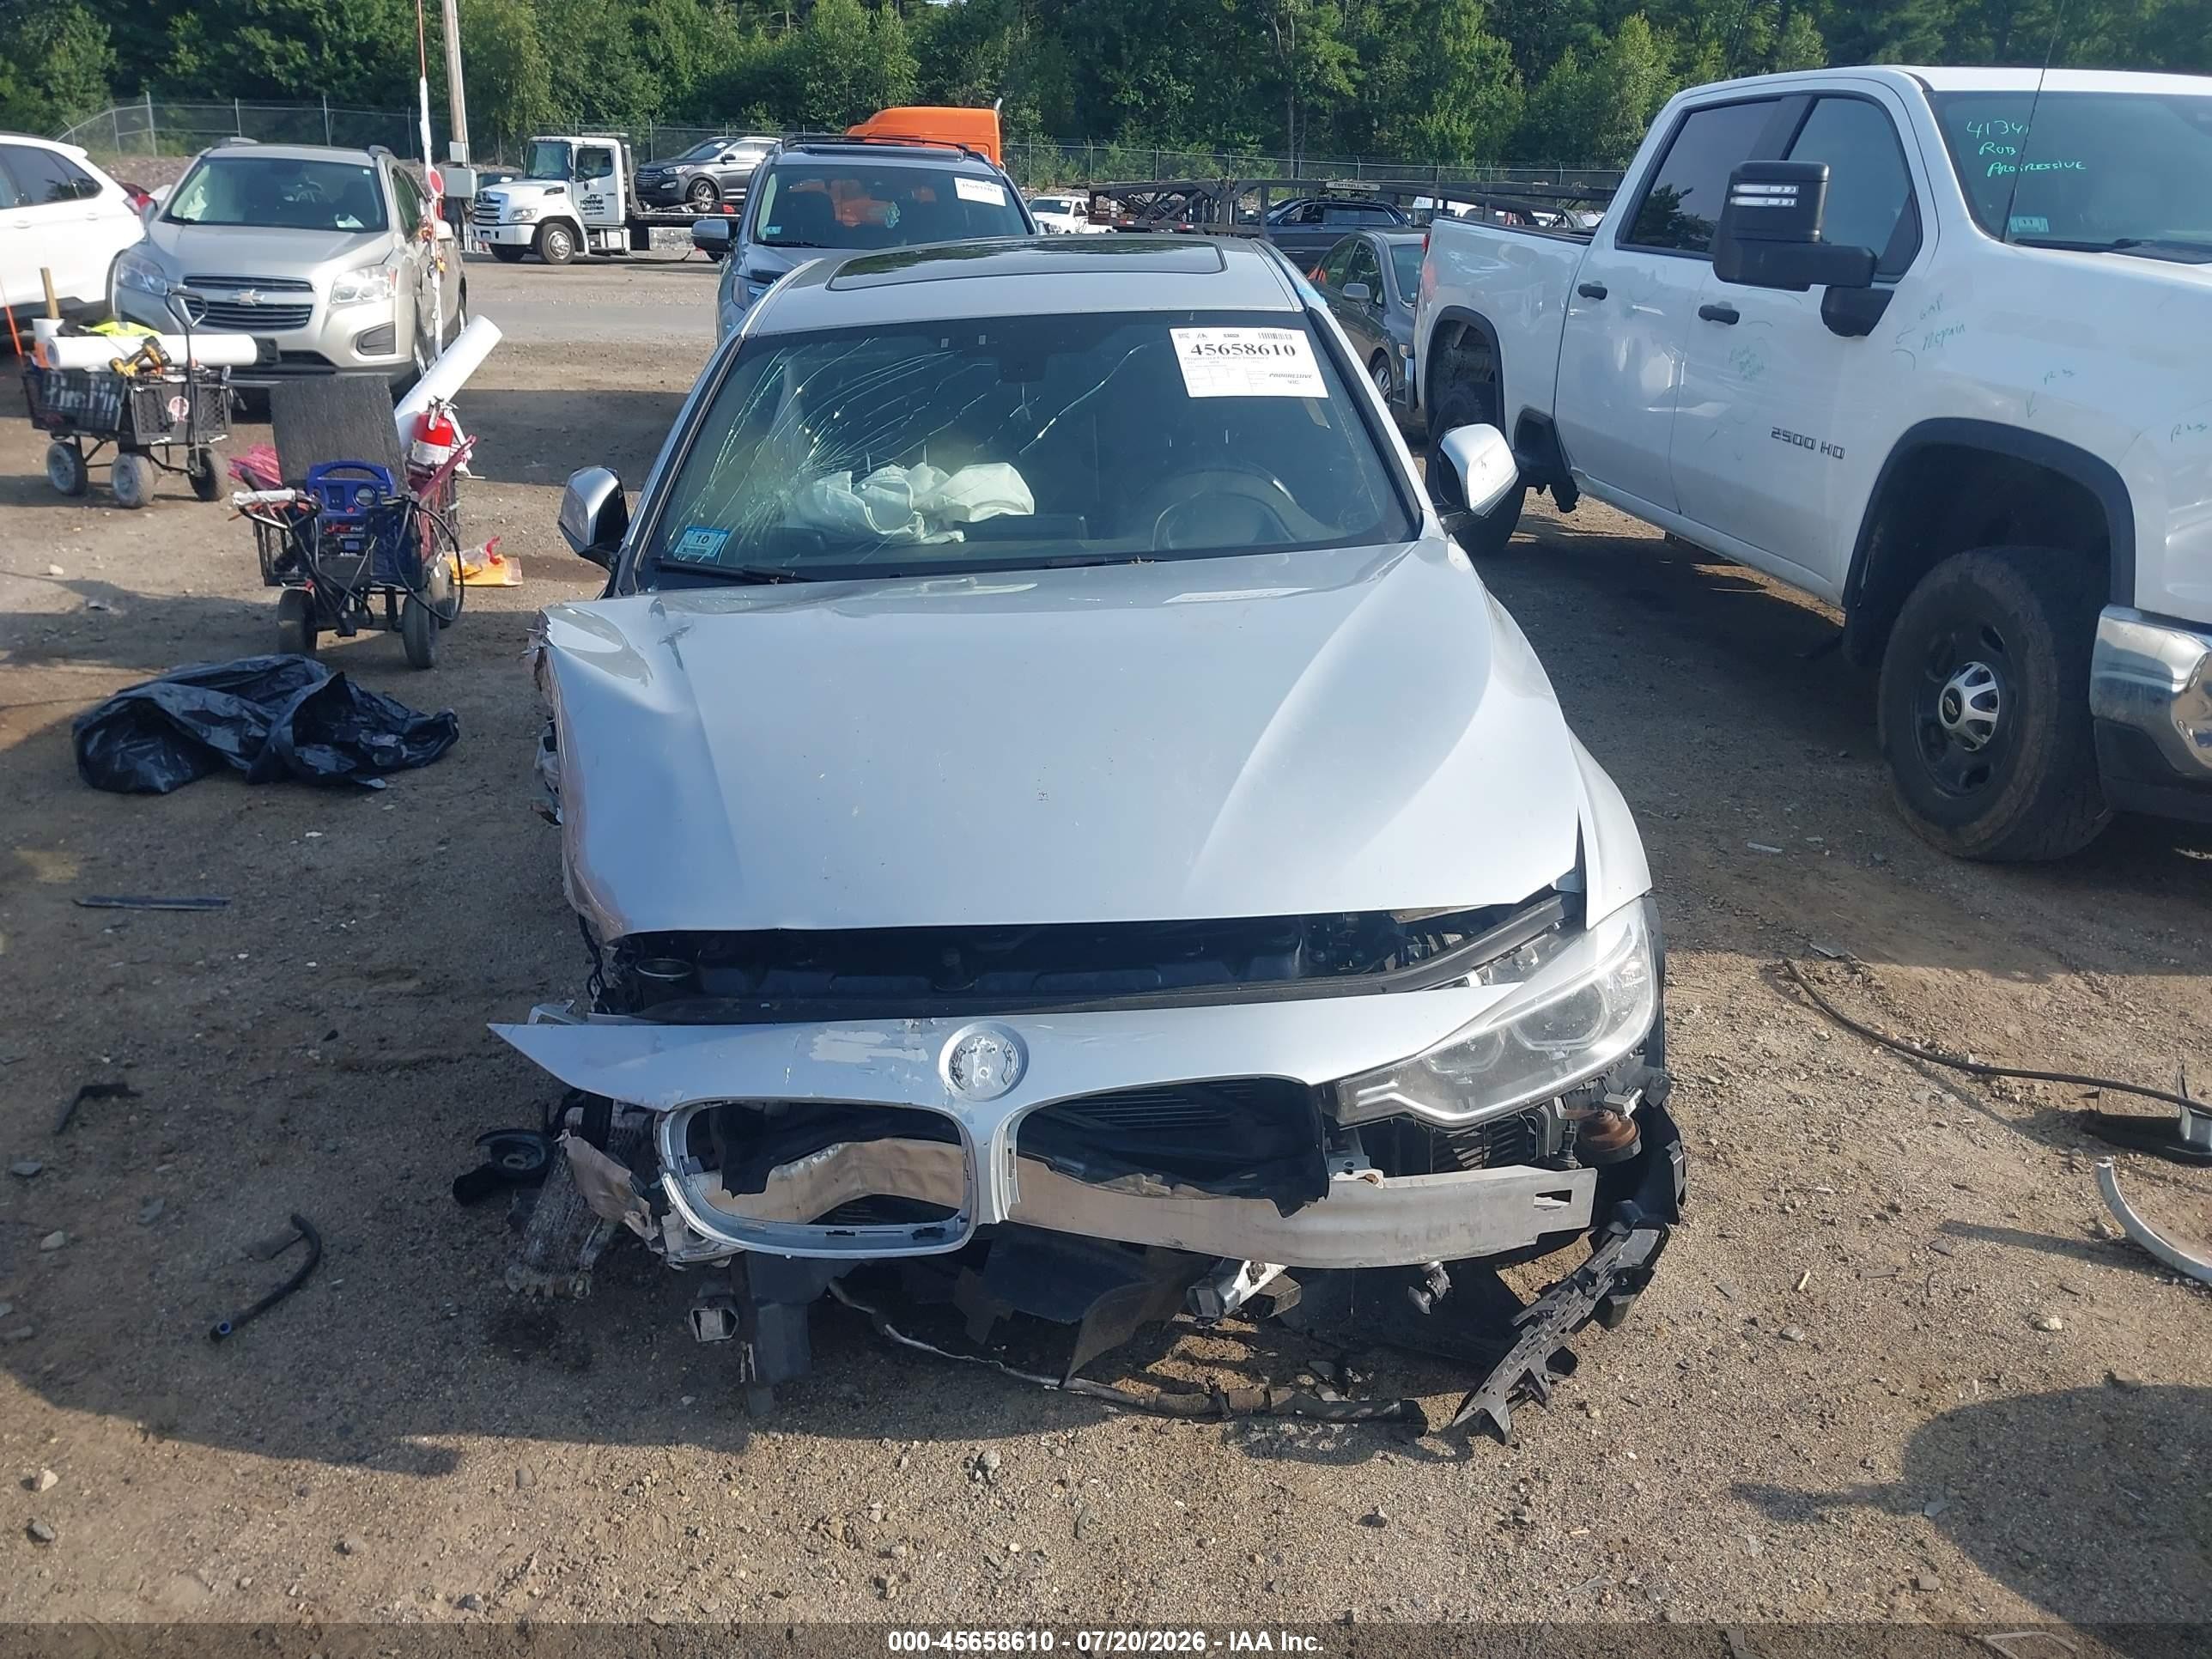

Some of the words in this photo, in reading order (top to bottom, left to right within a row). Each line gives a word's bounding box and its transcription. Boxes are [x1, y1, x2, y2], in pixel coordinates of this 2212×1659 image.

[1190, 343, 1297, 356] 45658610
[1771, 426, 1817, 451] 2500
[1820, 441, 1846, 460] HD
[696, 535, 710, 544] 10
